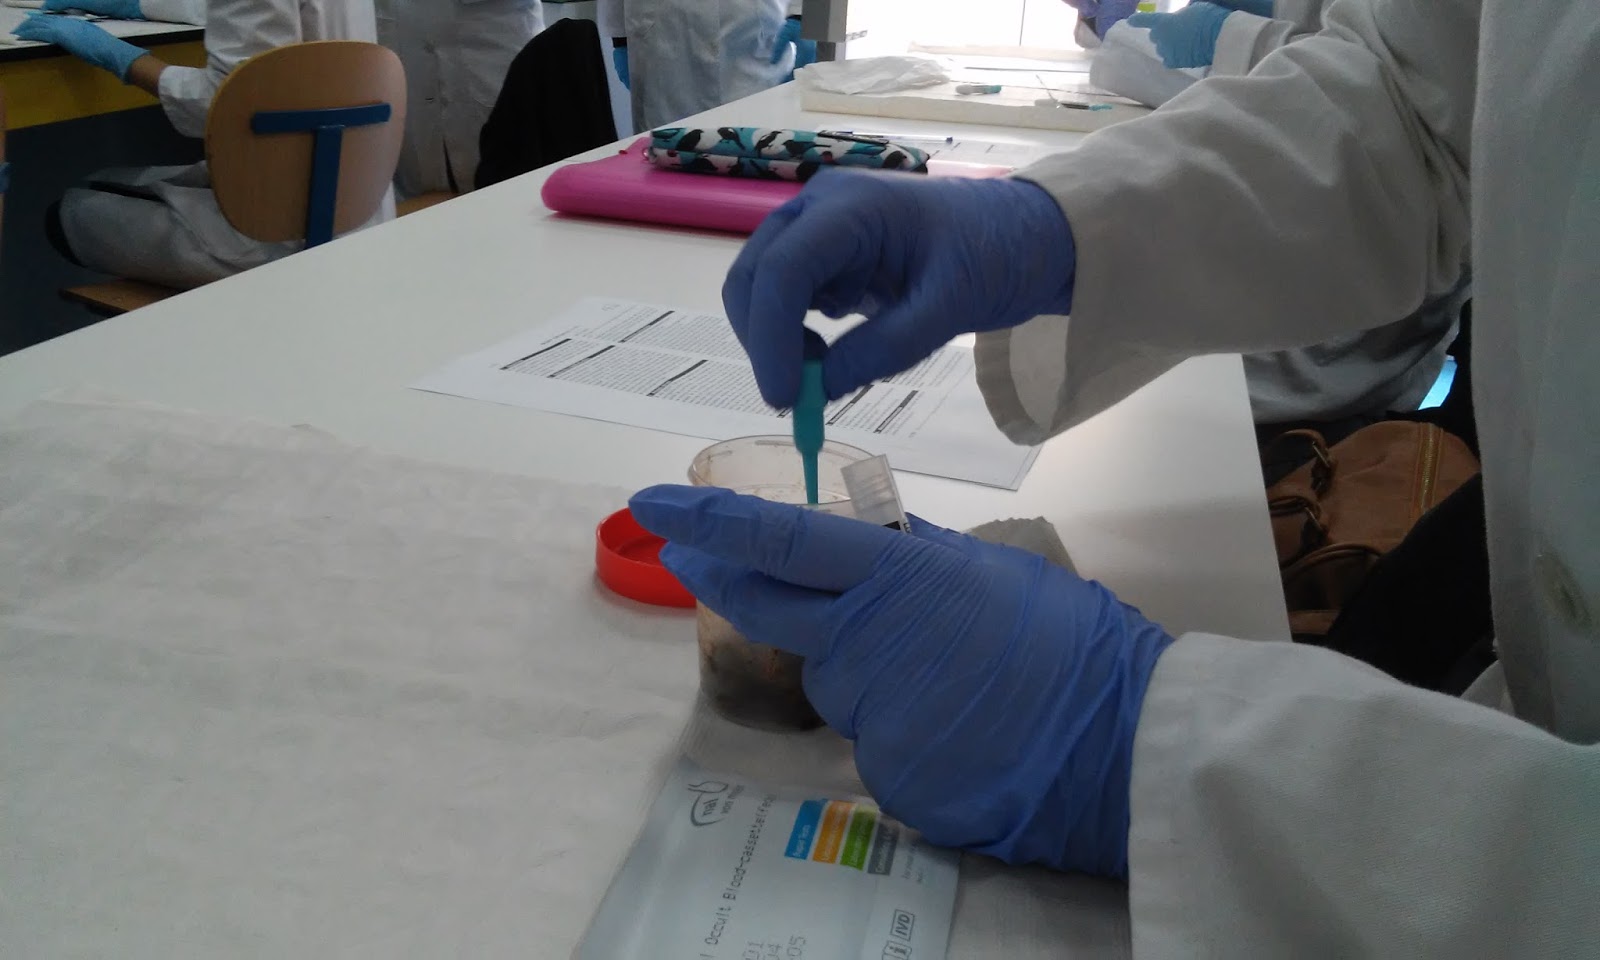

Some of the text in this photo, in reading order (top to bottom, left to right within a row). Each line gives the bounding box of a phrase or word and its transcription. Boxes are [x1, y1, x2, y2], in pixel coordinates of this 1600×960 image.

[702, 799, 719, 816] nal
[704, 907, 731, 944] Occult
[895, 914, 910, 936] IVD
